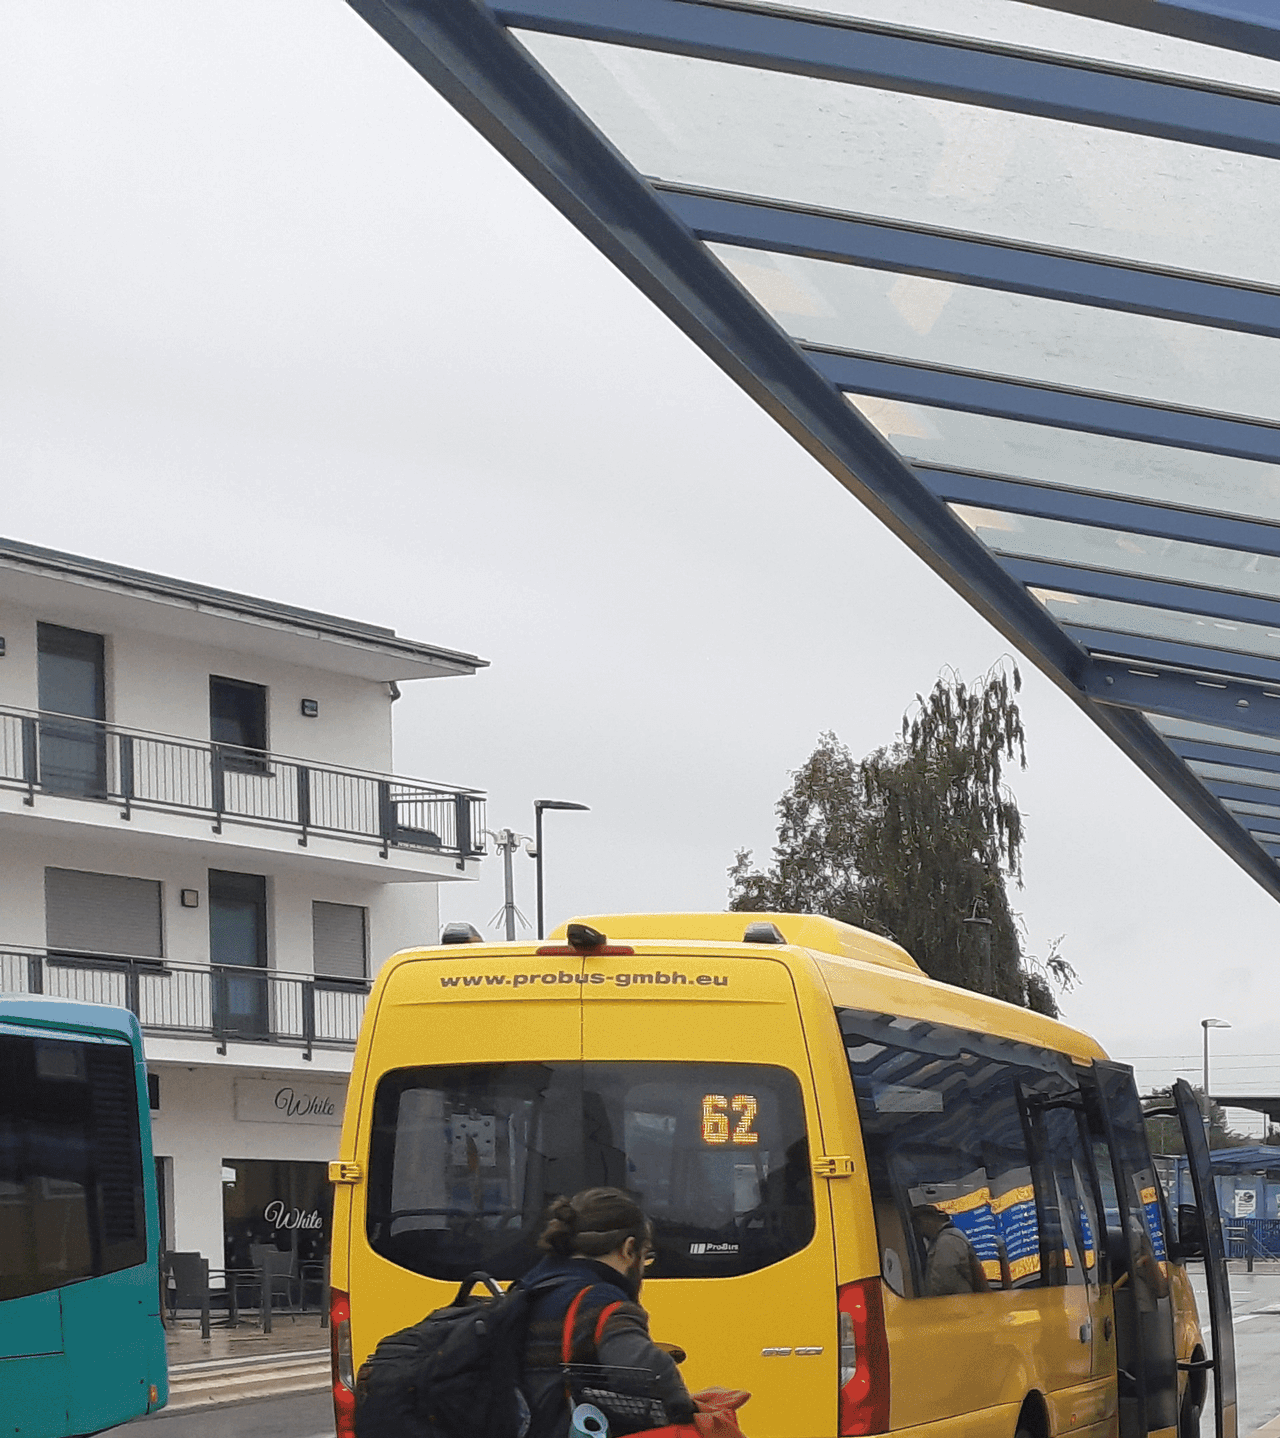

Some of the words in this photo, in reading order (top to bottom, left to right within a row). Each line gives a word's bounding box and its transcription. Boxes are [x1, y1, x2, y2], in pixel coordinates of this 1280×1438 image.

[440, 970, 729, 987] www.probus-gmbh.eu
[275, 1088, 334, 1116] White
[702, 1093, 758, 1143] 62
[265, 1201, 322, 1228] White
